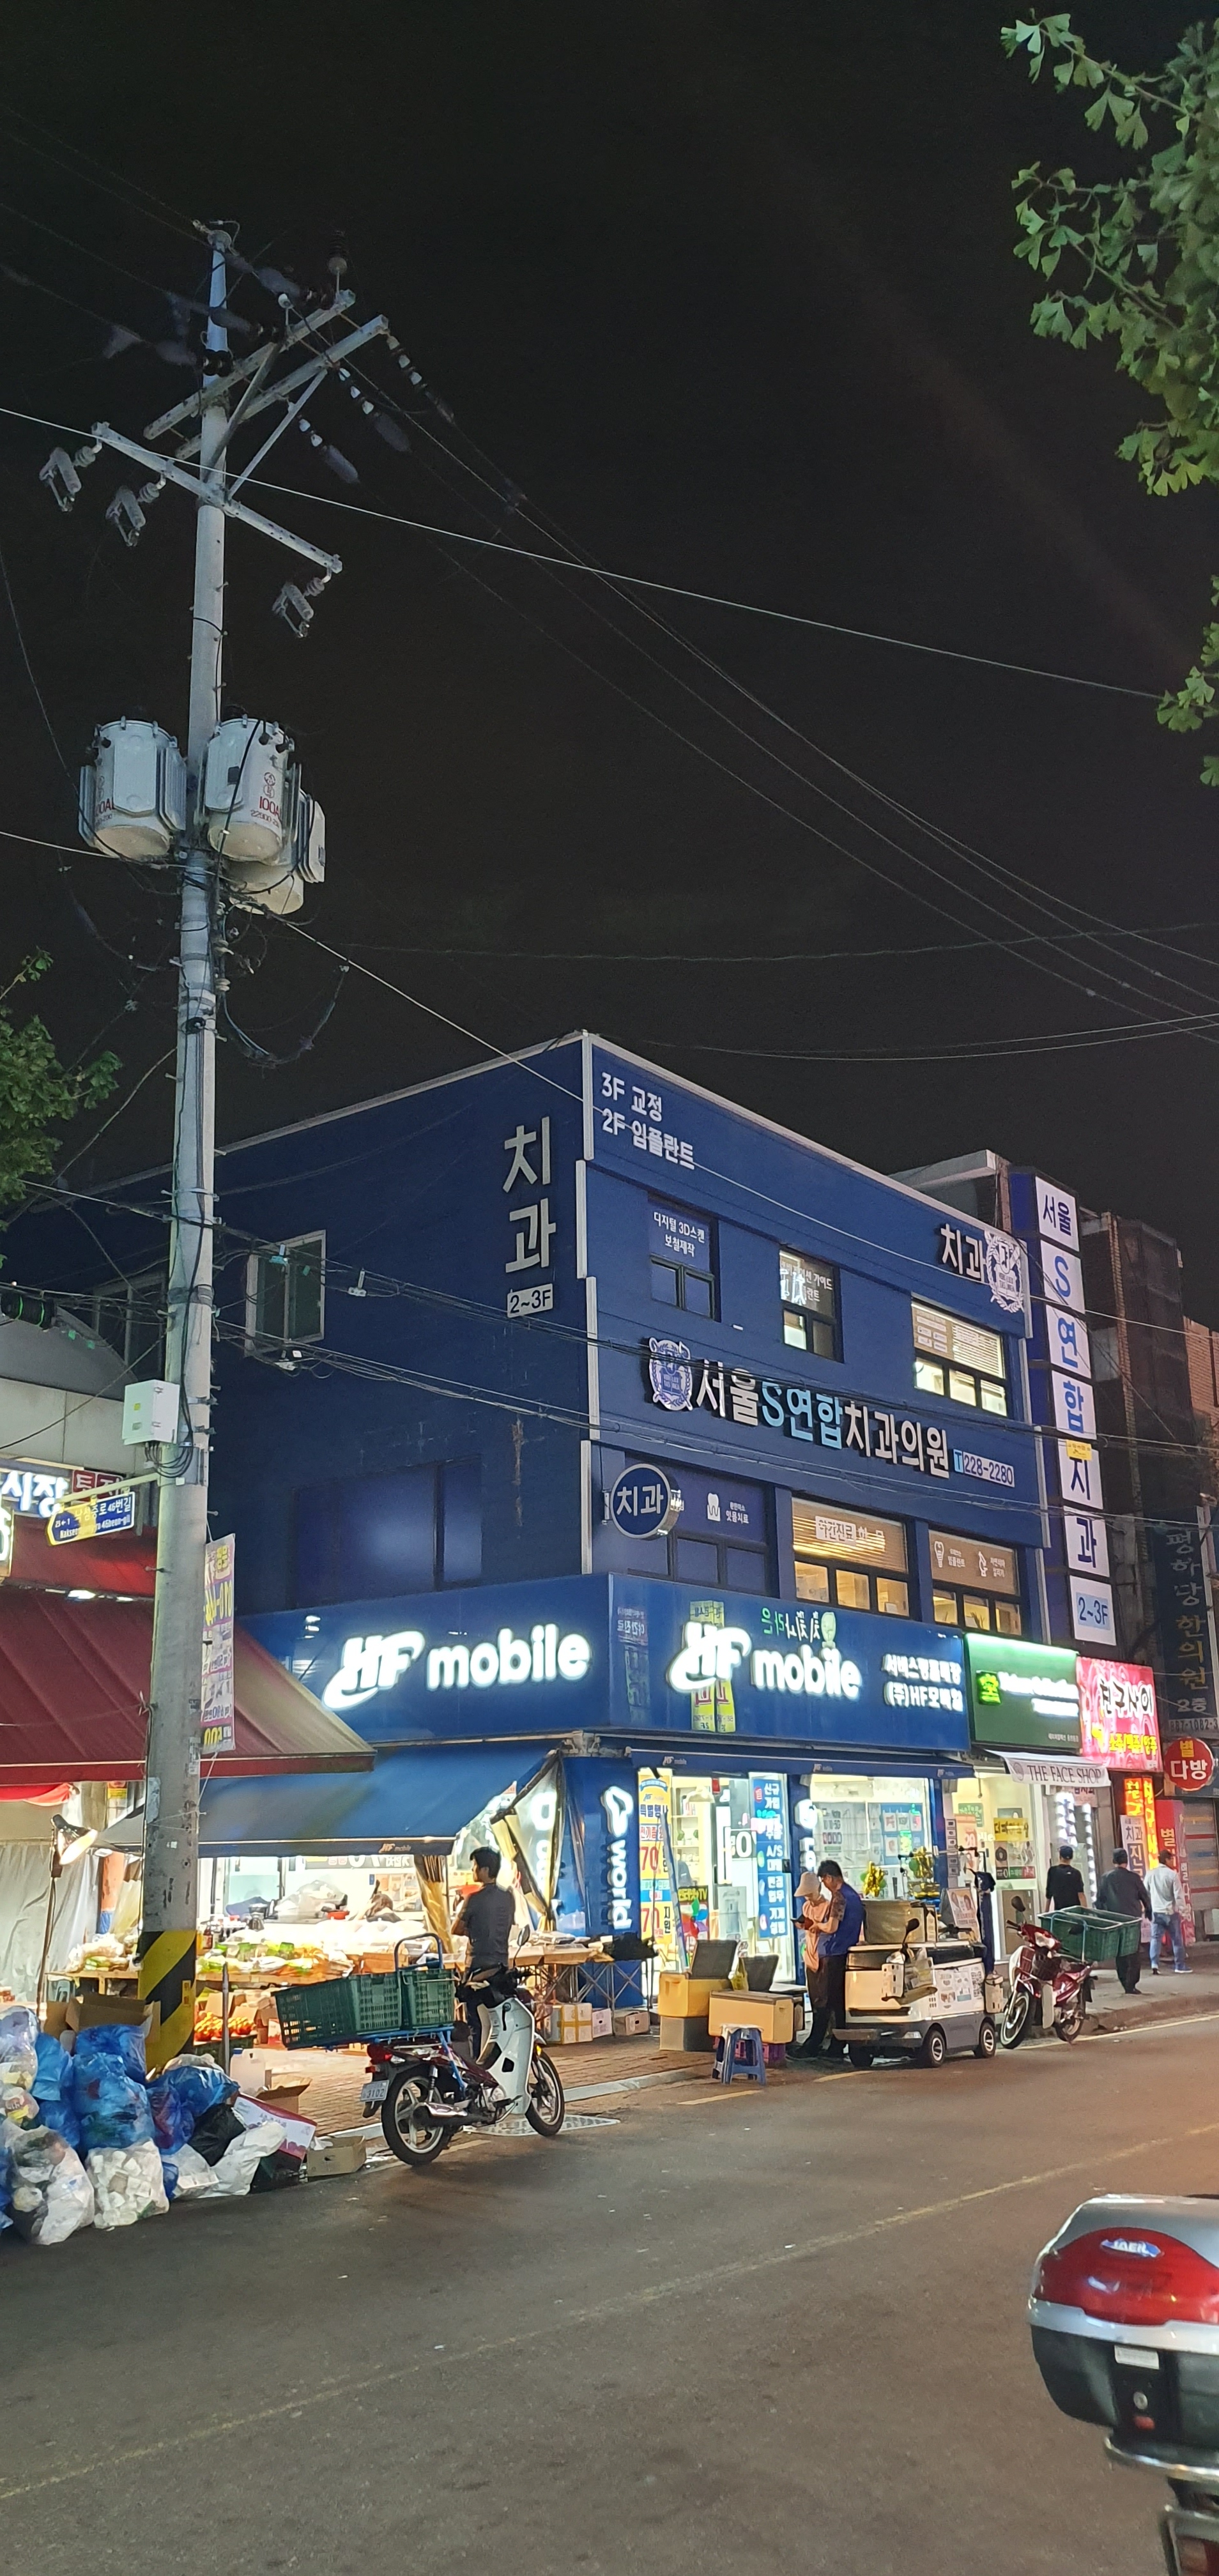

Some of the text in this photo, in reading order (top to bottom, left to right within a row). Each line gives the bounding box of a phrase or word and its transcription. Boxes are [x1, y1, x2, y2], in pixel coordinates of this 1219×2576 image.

[601, 1072, 662, 1121] 3F 교정
[602, 1108, 694, 1169] 2F 임플란트
[503, 1116, 556, 1273] 치과
[654, 1211, 705, 1243] 디지털 3D스캔
[665, 1234, 695, 1257] 보철제작
[940, 1223, 986, 1282] 치과
[813, 1273, 832, 1290] 가이드
[696, 1360, 949, 1479] 서울S연합치과의원
[964, 1453, 1013, 1486] 228-2280
[1, 1471, 69, 1518] 시장
[617, 1483, 664, 1517] 치과
[427, 1623, 591, 1691] mobile
[751, 1644, 862, 1699] mobile
[1177, 1698, 1206, 1712] 2층
[1027, 1765, 1101, 1784] THE FACE SHOP
[1170, 1759, 1208, 1780] 다방
[1126, 1825, 1143, 1841] 치과
[766, 1844, 783, 1857] A/S
[610, 1839, 632, 1929] world
